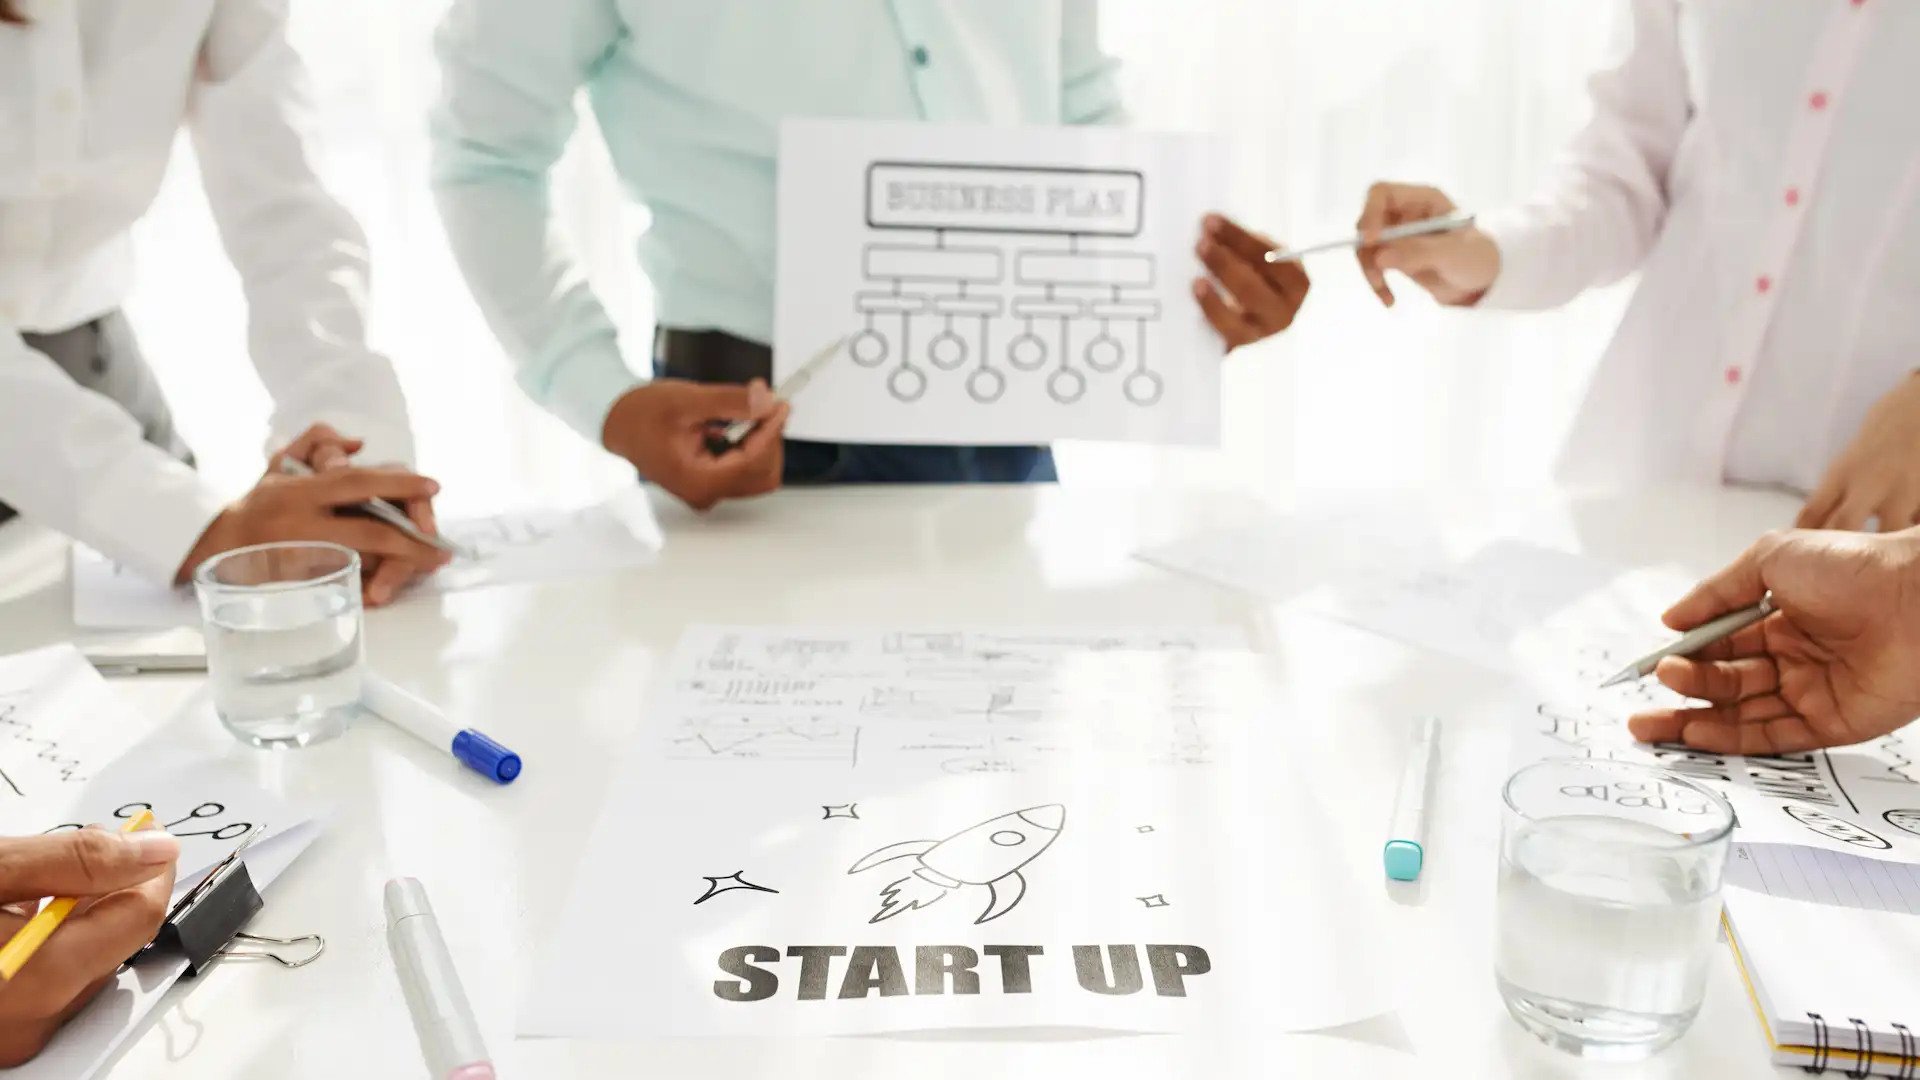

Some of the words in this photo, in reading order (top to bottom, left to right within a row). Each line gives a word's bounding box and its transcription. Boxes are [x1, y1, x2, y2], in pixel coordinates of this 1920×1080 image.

[886, 180, 1035, 214] BUSINESS
[1045, 186, 1125, 218] PLAN
[714, 944, 1044, 1001] START
[1072, 943, 1211, 997] UP
